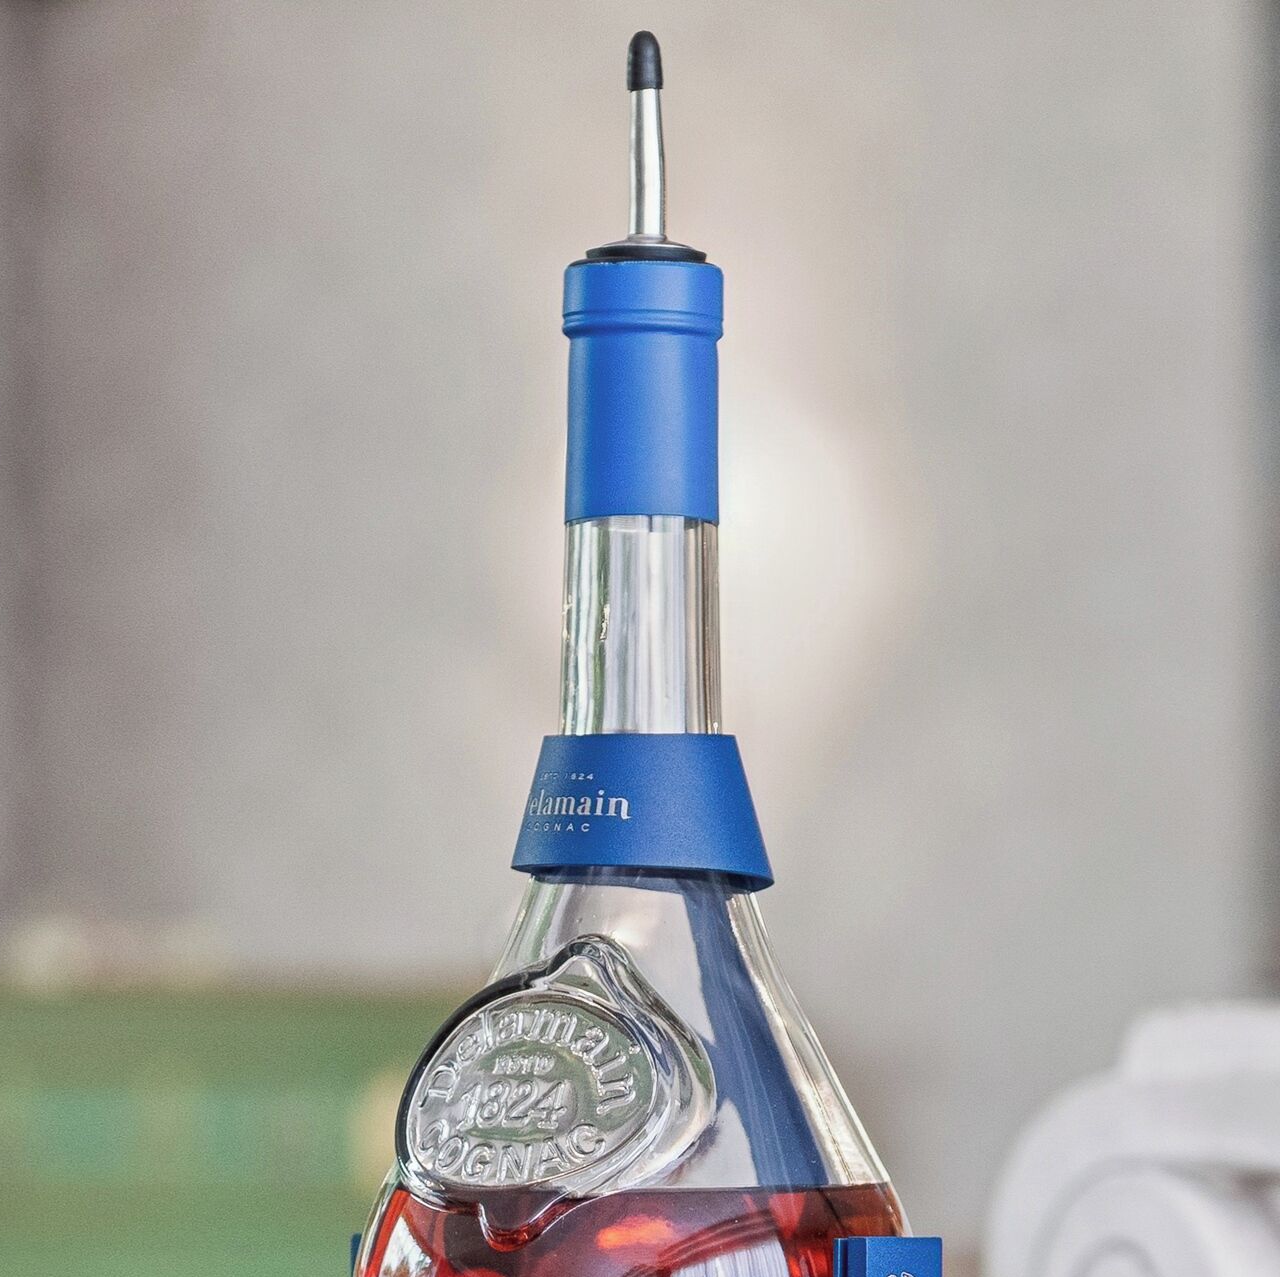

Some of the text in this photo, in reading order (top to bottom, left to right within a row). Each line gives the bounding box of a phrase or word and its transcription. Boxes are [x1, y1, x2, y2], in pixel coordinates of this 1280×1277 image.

[528, 789, 632, 820] elamain
[418, 1008, 642, 1115] Delamain
[455, 1078, 571, 1130] 1824
[418, 1118, 607, 1183] COGNAC
